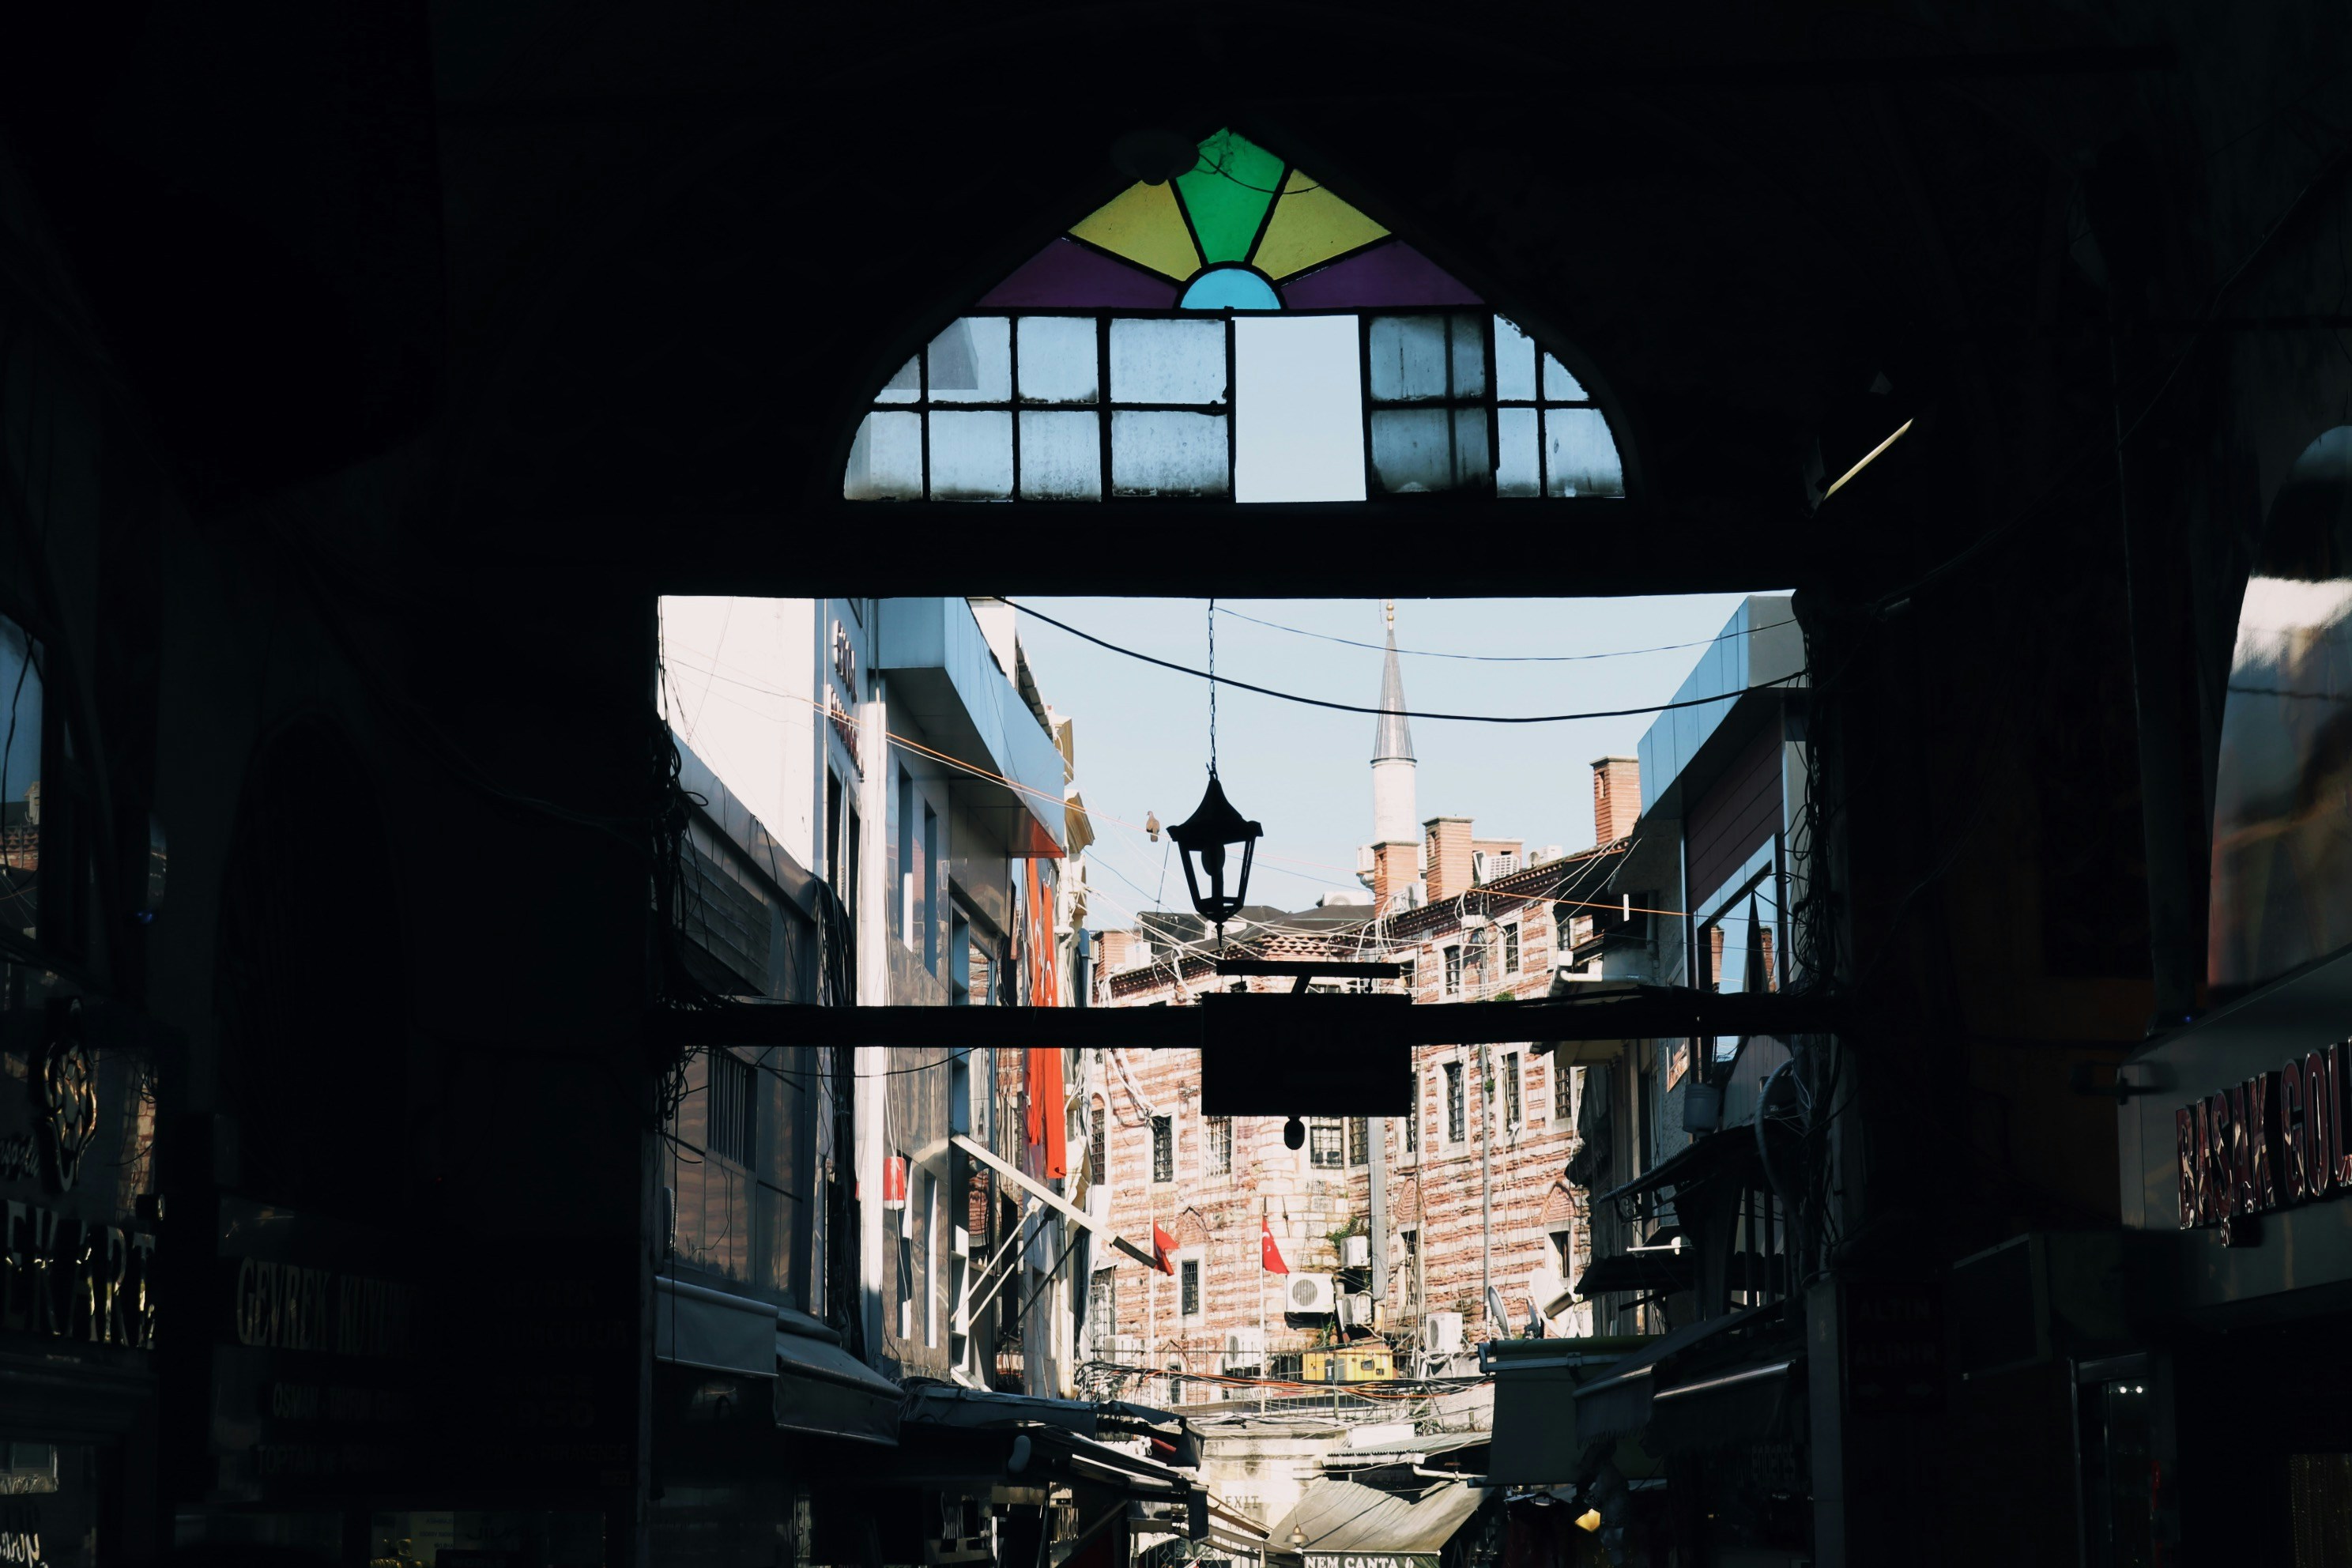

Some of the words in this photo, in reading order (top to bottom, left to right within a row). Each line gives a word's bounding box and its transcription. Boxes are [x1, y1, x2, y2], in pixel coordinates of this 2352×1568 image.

[2175, 1071, 2276, 1249] BAŞAK
[2281, 1035, 2352, 1204] GOL
[237, 1256, 332, 1352] GEVREK
[1225, 1495, 1259, 1510] EXIT
